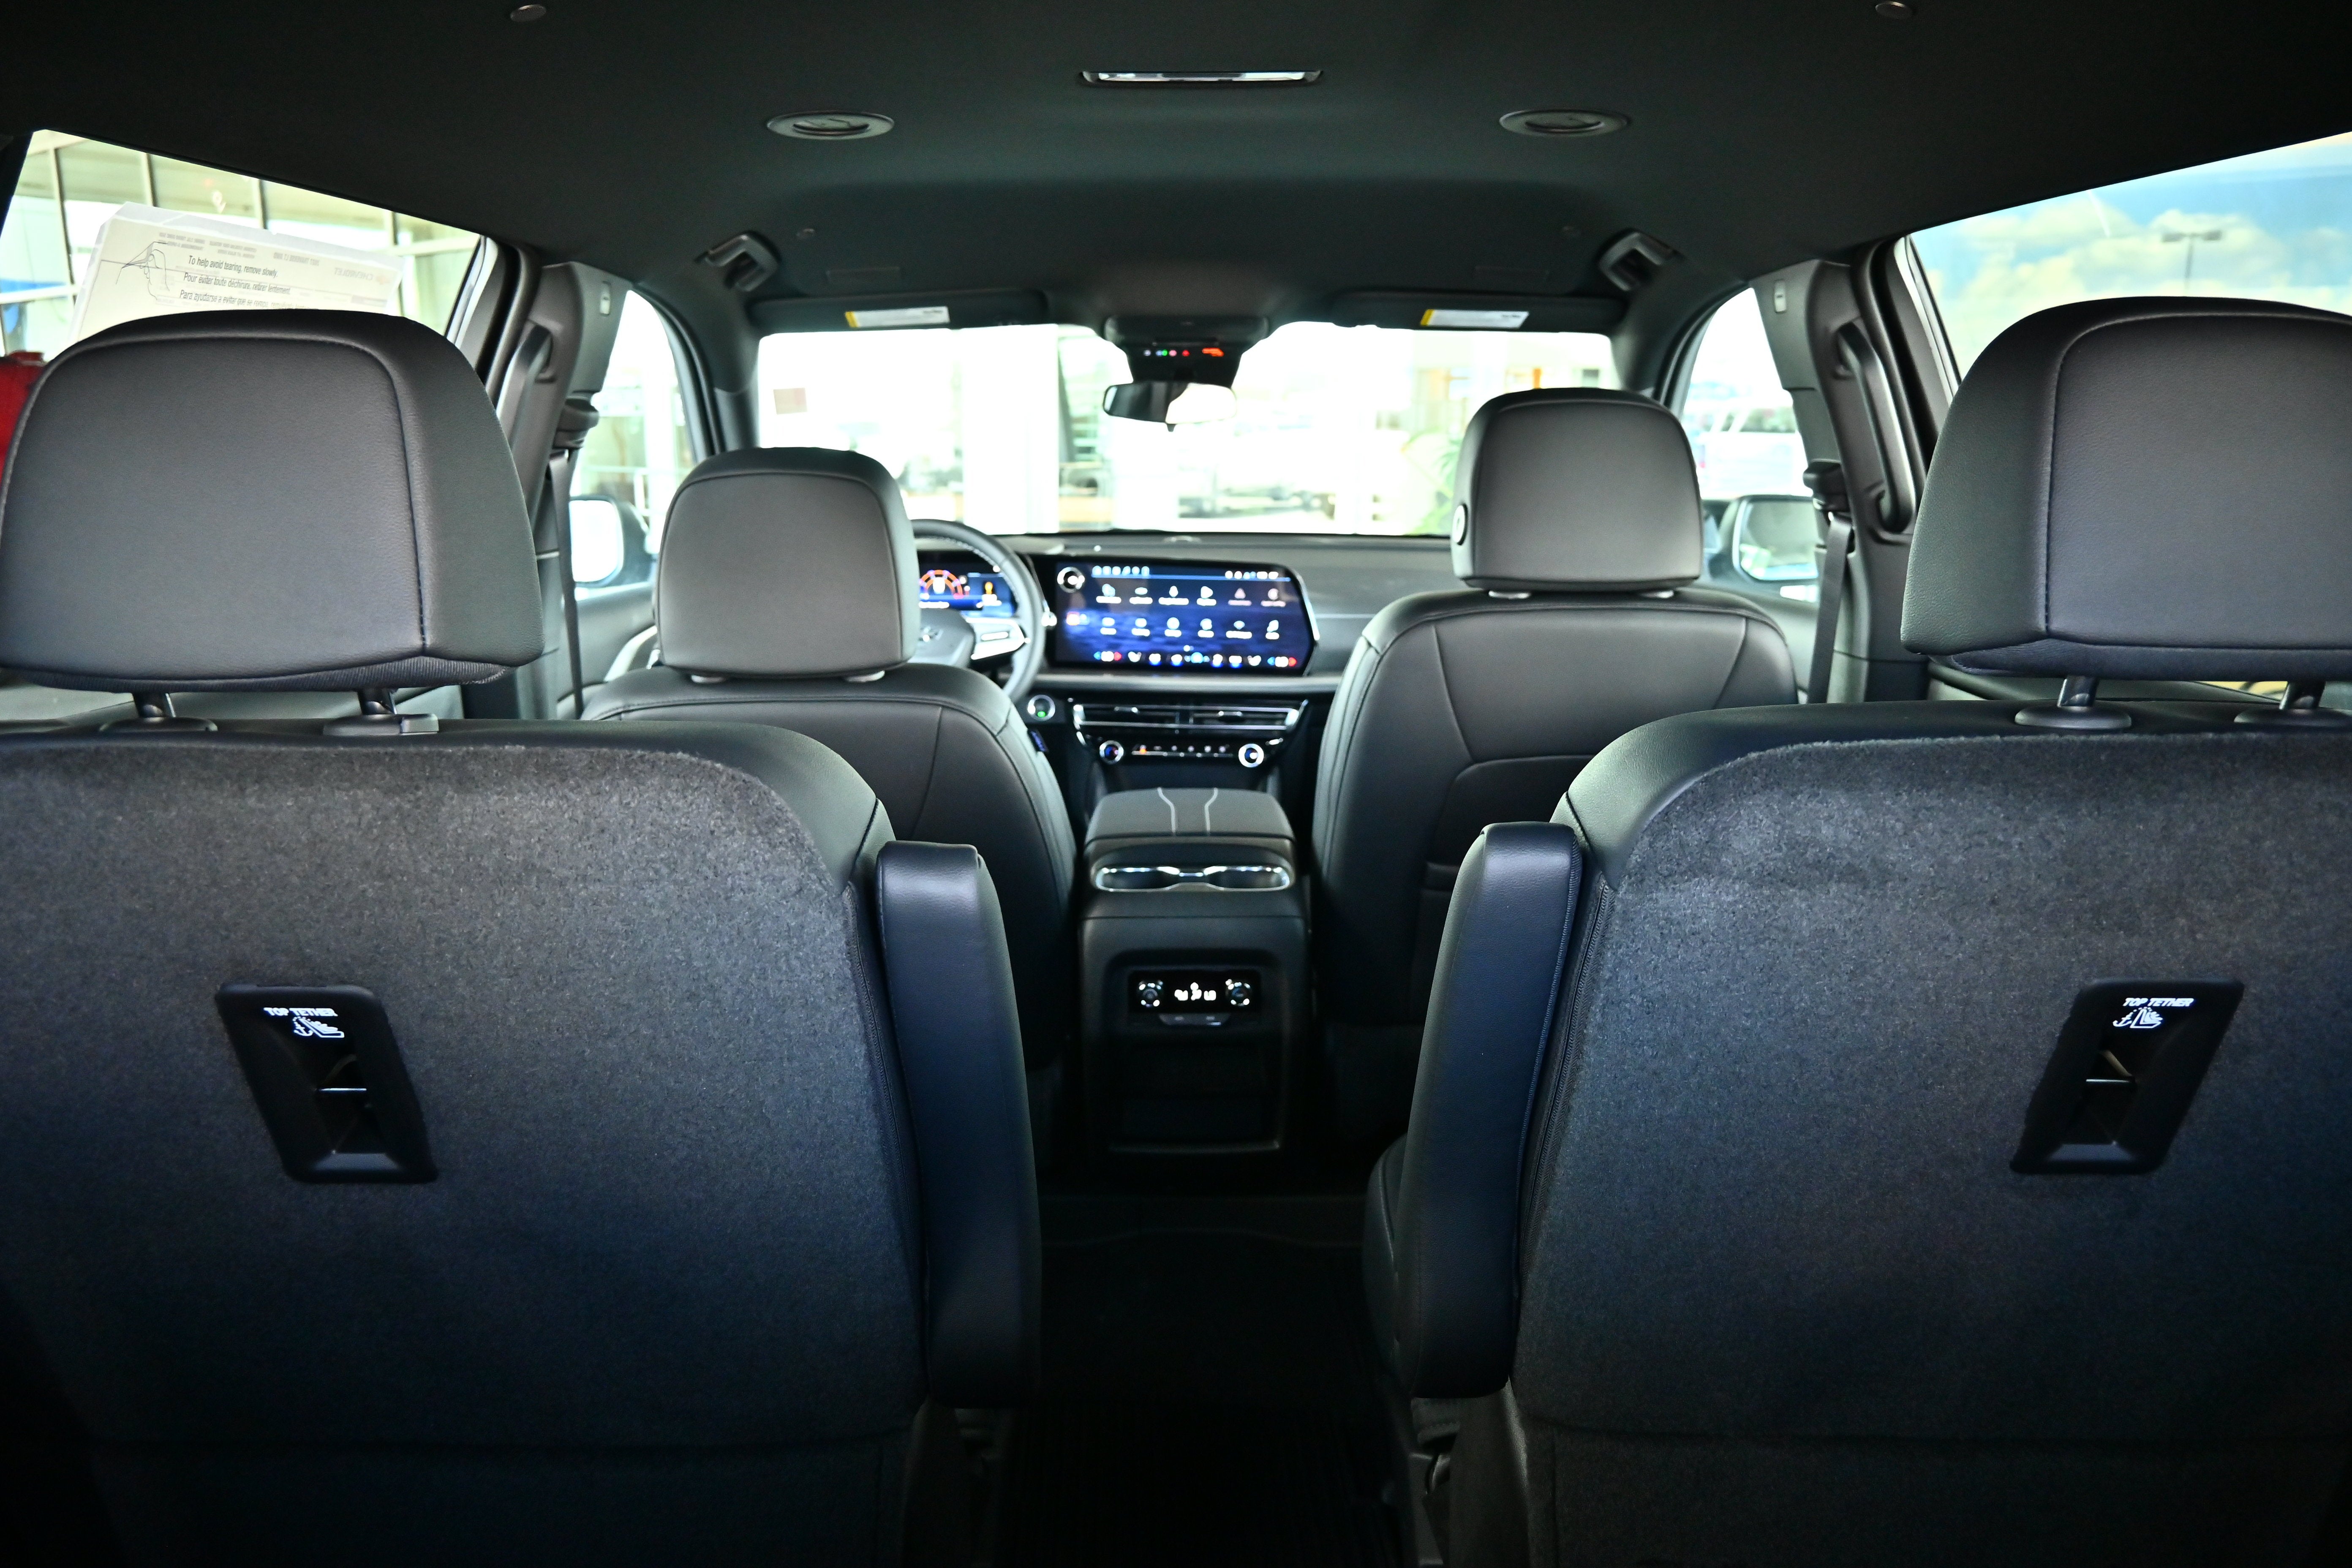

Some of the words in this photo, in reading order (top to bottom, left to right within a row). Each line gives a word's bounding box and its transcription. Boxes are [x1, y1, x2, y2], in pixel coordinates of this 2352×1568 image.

[188, 255, 196, 265] To
[196, 257, 208, 268] help
[210, 260, 223, 269] avoid
[224, 261, 242, 274] tearing,
[244, 266, 261, 275] remove
[262, 267, 278, 279] slowly.
[183, 272, 198, 283] Pour
[198, 275, 214, 285] éviter
[214, 277, 227, 286] toute
[252, 282, 267, 291] retirer
[180, 289, 193, 299] Para
[194, 293, 218, 302] ayudarse
[2123, 998, 2148, 1006] TOP
[2147, 998, 2194, 1007] TETHER
[263, 1007, 289, 1016] TOP
[289, 1007, 338, 1016] TETHER
